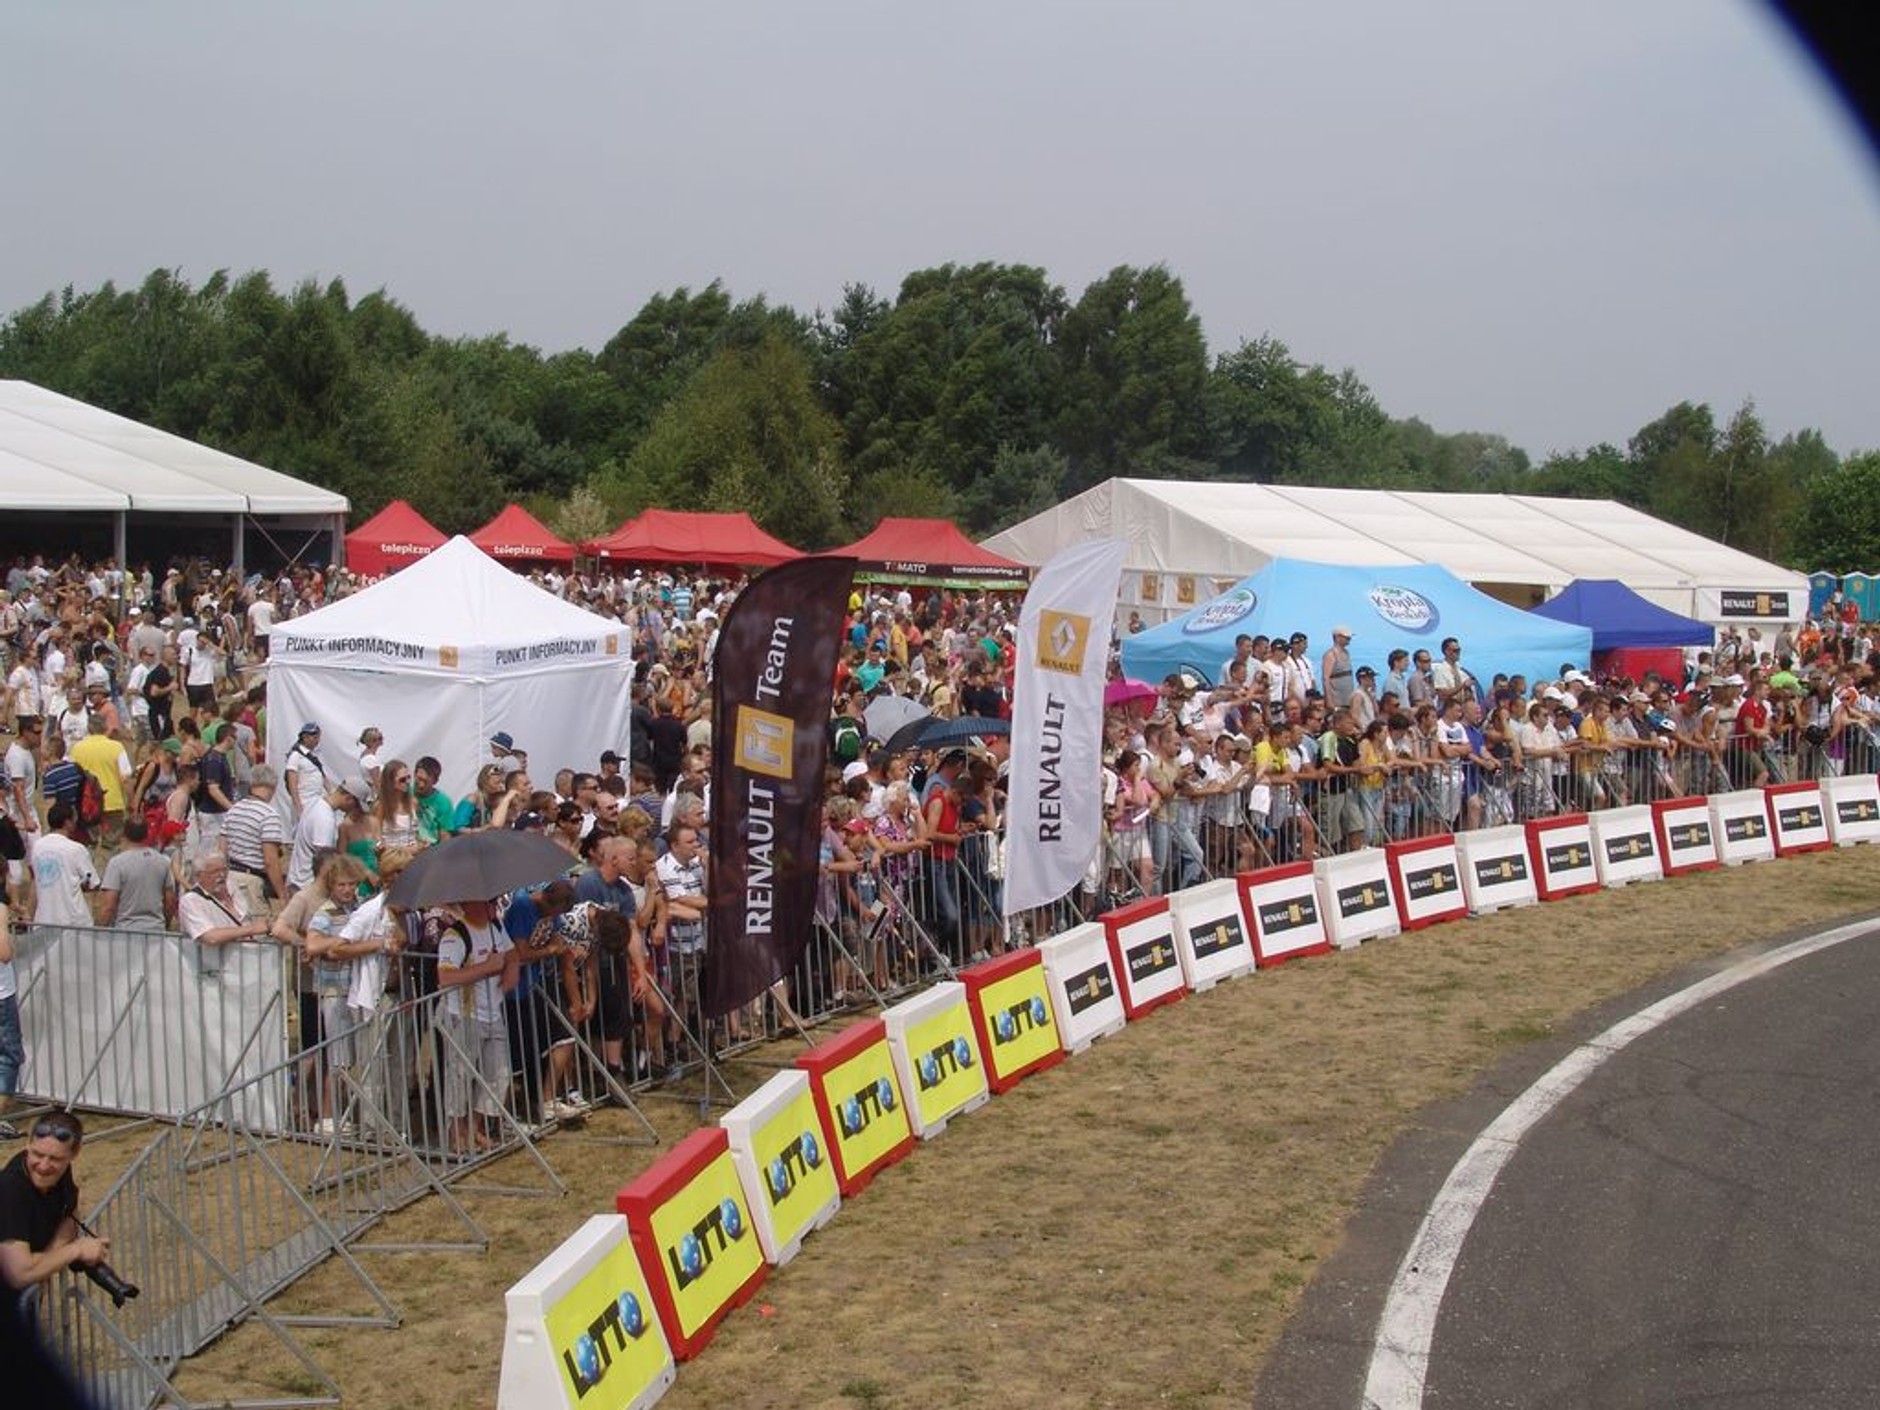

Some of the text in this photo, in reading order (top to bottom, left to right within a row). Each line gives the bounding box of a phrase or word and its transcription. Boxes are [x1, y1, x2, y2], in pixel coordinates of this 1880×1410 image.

[286, 637, 425, 660] PUNKT INFORMACYJNY
[495, 639, 598, 666] PUNKT INFORMACYJNY
[756, 615, 795, 702] Team
[1040, 658, 1081, 674] RENAULT
[1039, 692, 1067, 843] RENAULT
[745, 778, 776, 936] RENAULT
[990, 996, 1048, 1046] LOTTO
[914, 1036, 972, 1092] LOTTO
[835, 1077, 895, 1141] LOTTO
[763, 1131, 820, 1207] LOTTO
[668, 1198, 744, 1292] LOTTO
[563, 1290, 646, 1400] LOTTO
